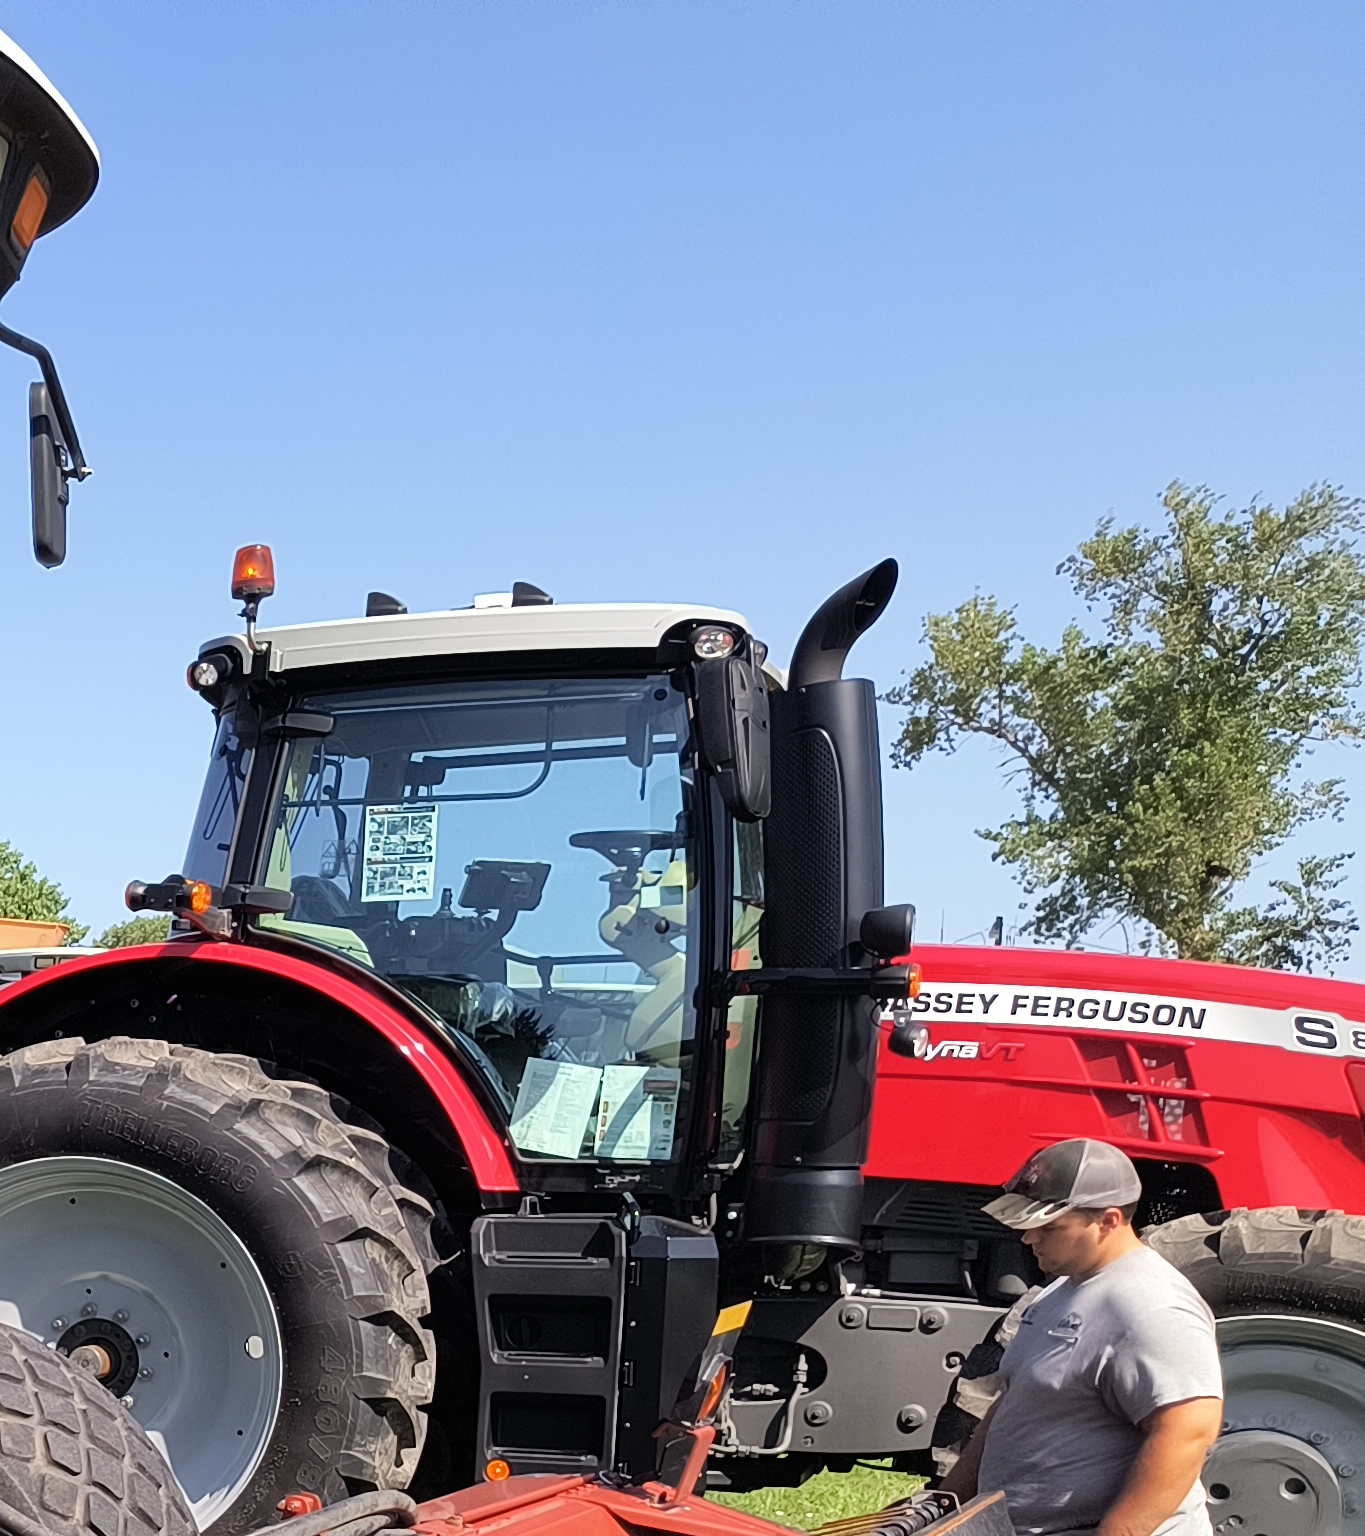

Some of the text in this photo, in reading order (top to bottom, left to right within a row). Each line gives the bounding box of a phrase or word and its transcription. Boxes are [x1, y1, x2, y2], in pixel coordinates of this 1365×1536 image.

[881, 992, 1208, 1030] ASSEY FERGUSON
[1294, 1015, 1338, 1050] S
[77, 1096, 258, 1193] TRELLEBORG
